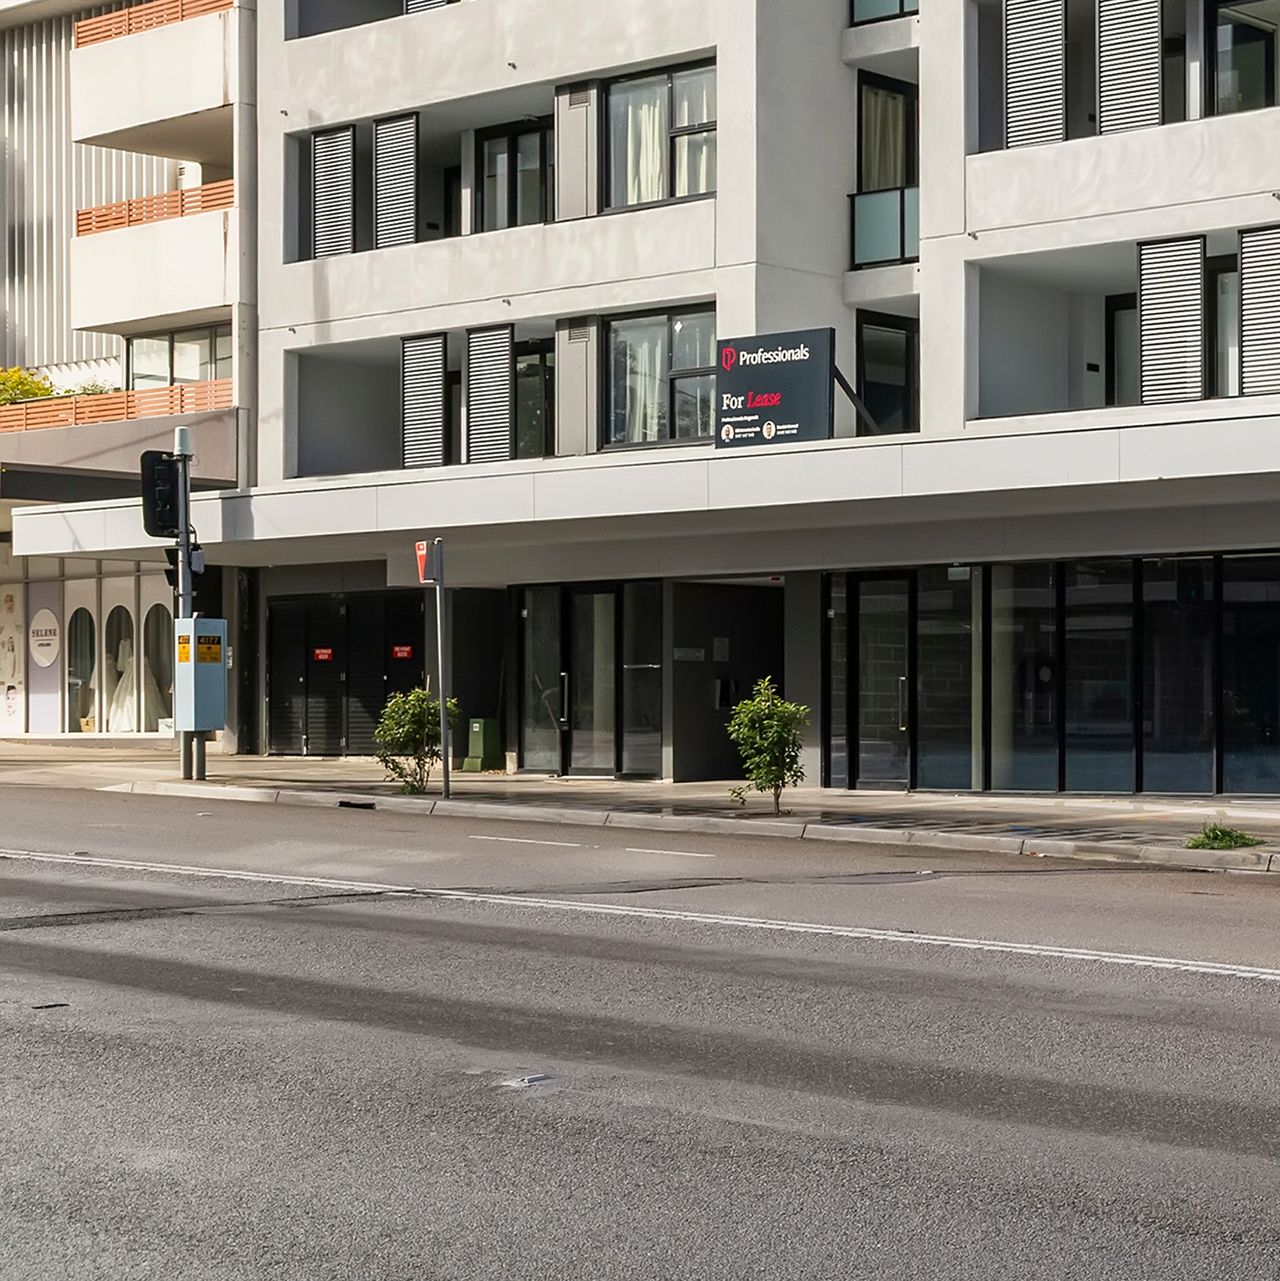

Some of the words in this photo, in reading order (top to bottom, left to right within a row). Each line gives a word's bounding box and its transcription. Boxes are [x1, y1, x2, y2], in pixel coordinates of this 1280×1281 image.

[739, 344, 810, 366] Professionals
[722, 393, 745, 410] For
[746, 391, 782, 408] Lease
[31, 628, 57, 638] SELENE
